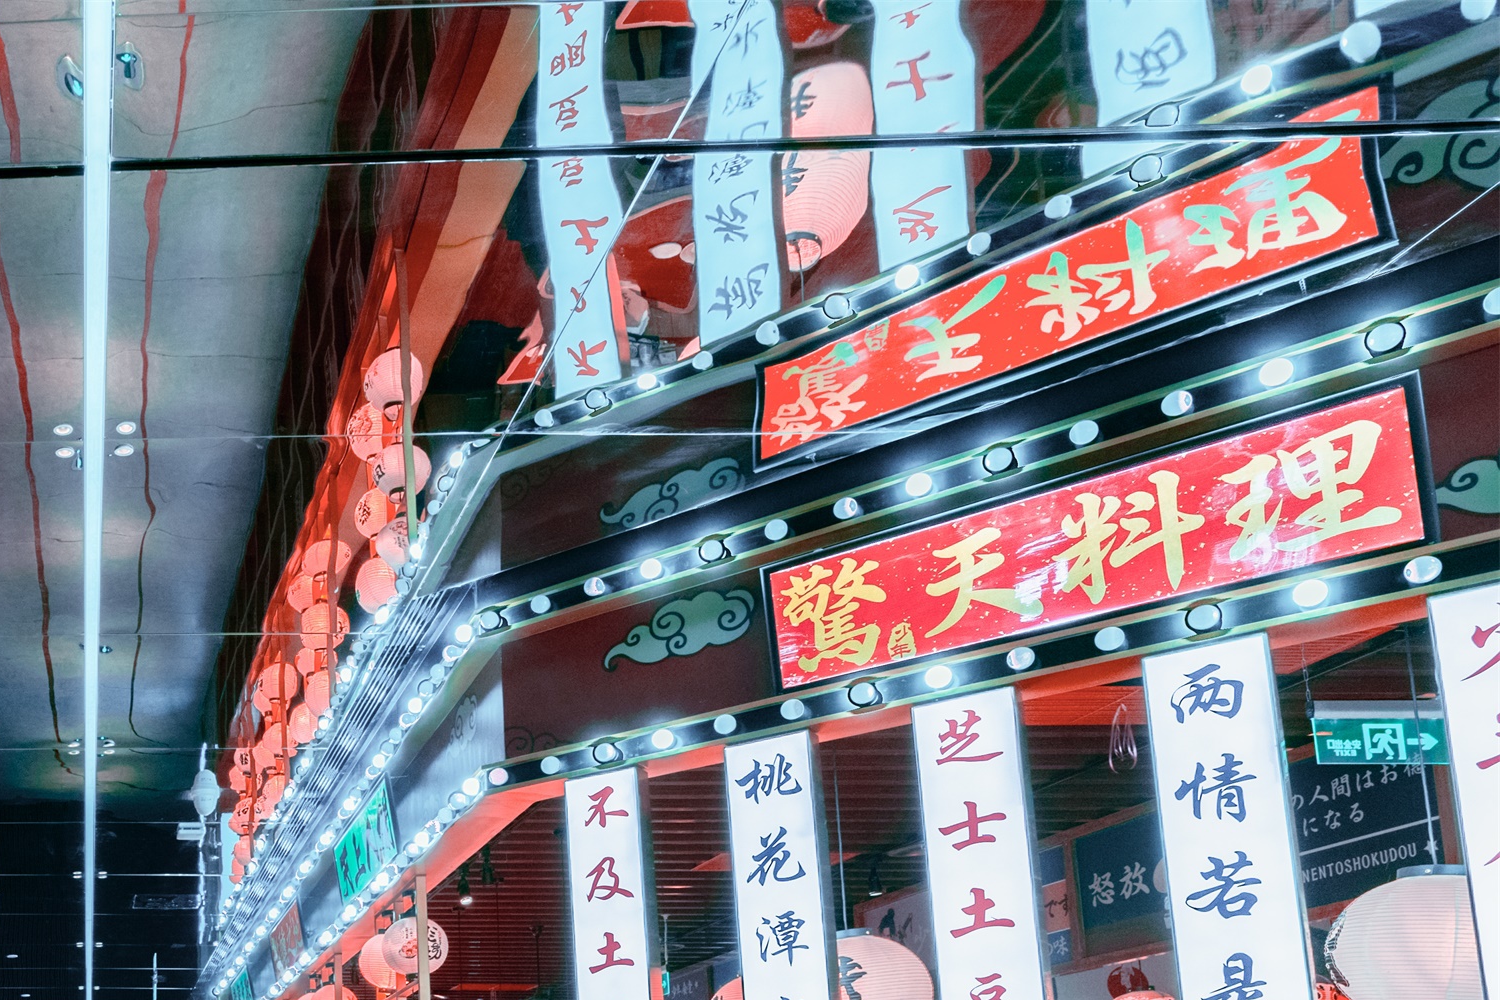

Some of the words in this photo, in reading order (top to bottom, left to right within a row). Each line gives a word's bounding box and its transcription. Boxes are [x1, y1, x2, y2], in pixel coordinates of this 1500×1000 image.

[780, 418, 1402, 673] 驚天料理
[1303, 802, 1365, 837] になる
[1088, 861, 1151, 908] 怒放
